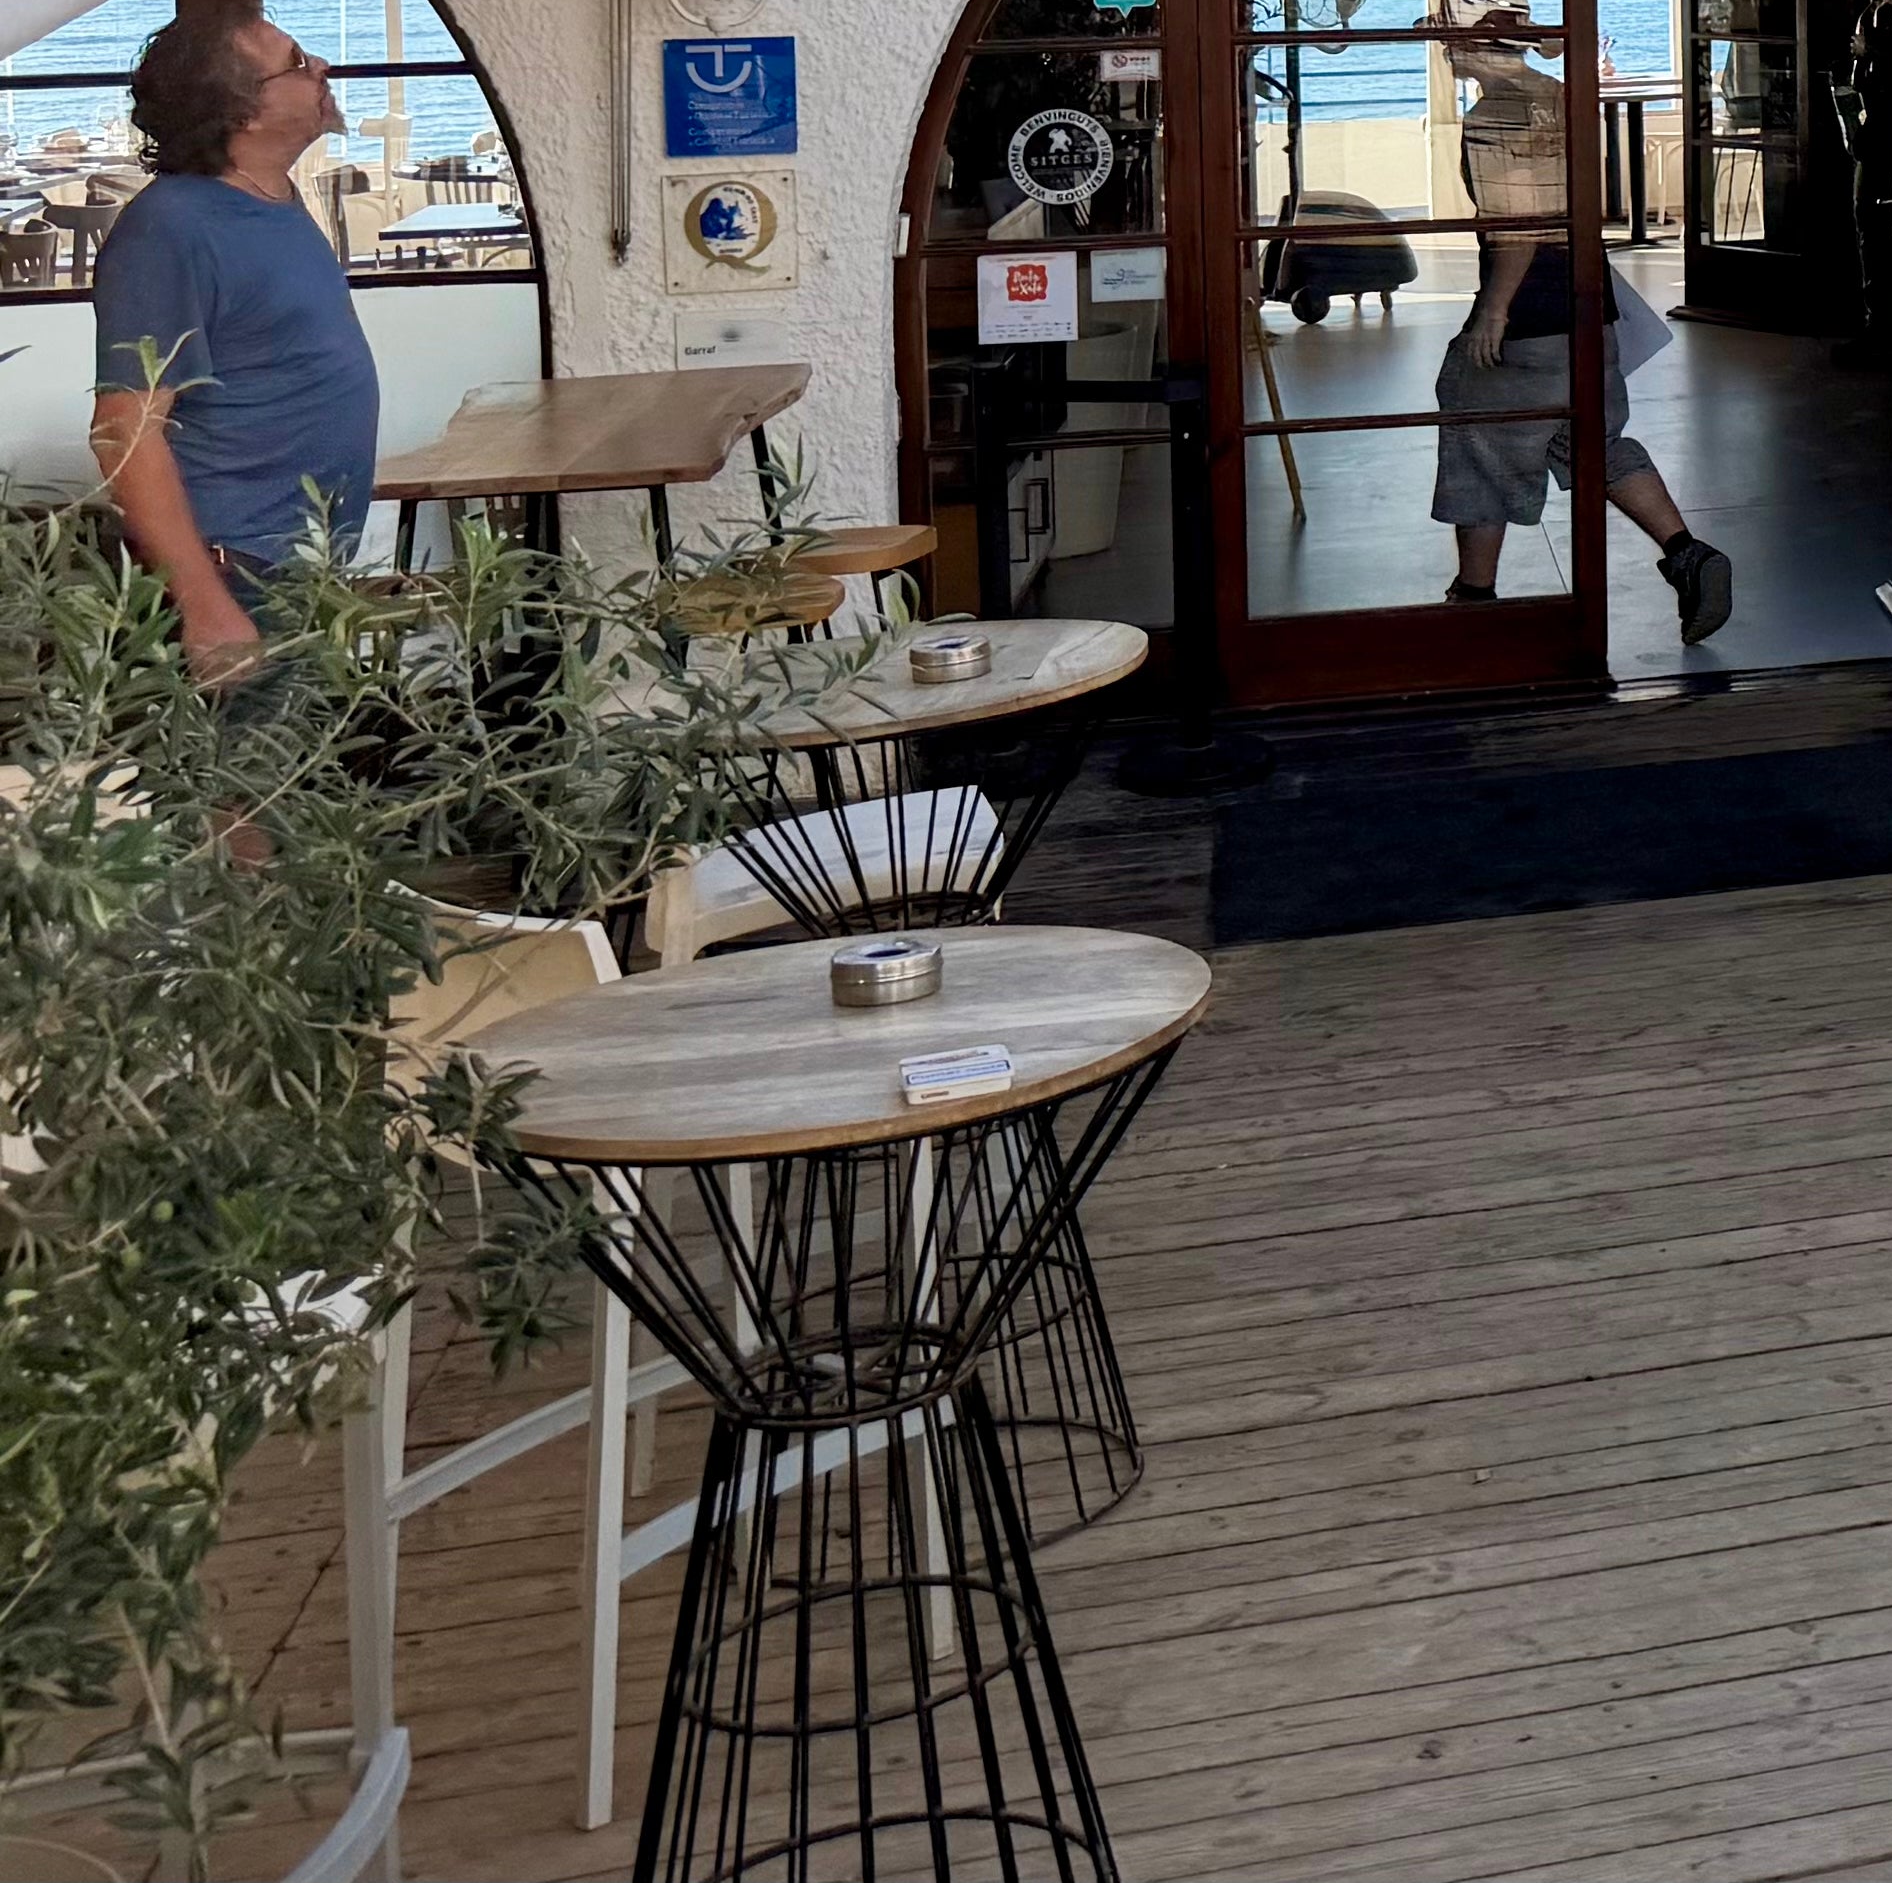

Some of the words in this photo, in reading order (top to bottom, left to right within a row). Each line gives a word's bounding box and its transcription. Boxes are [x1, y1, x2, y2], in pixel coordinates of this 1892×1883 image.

[1019, 111, 1100, 137] BENVINGUTS
[1030, 154, 1093, 167] SITGES
[1010, 144, 1046, 200] WELCOME
[684, 345, 717, 357] Garraf
